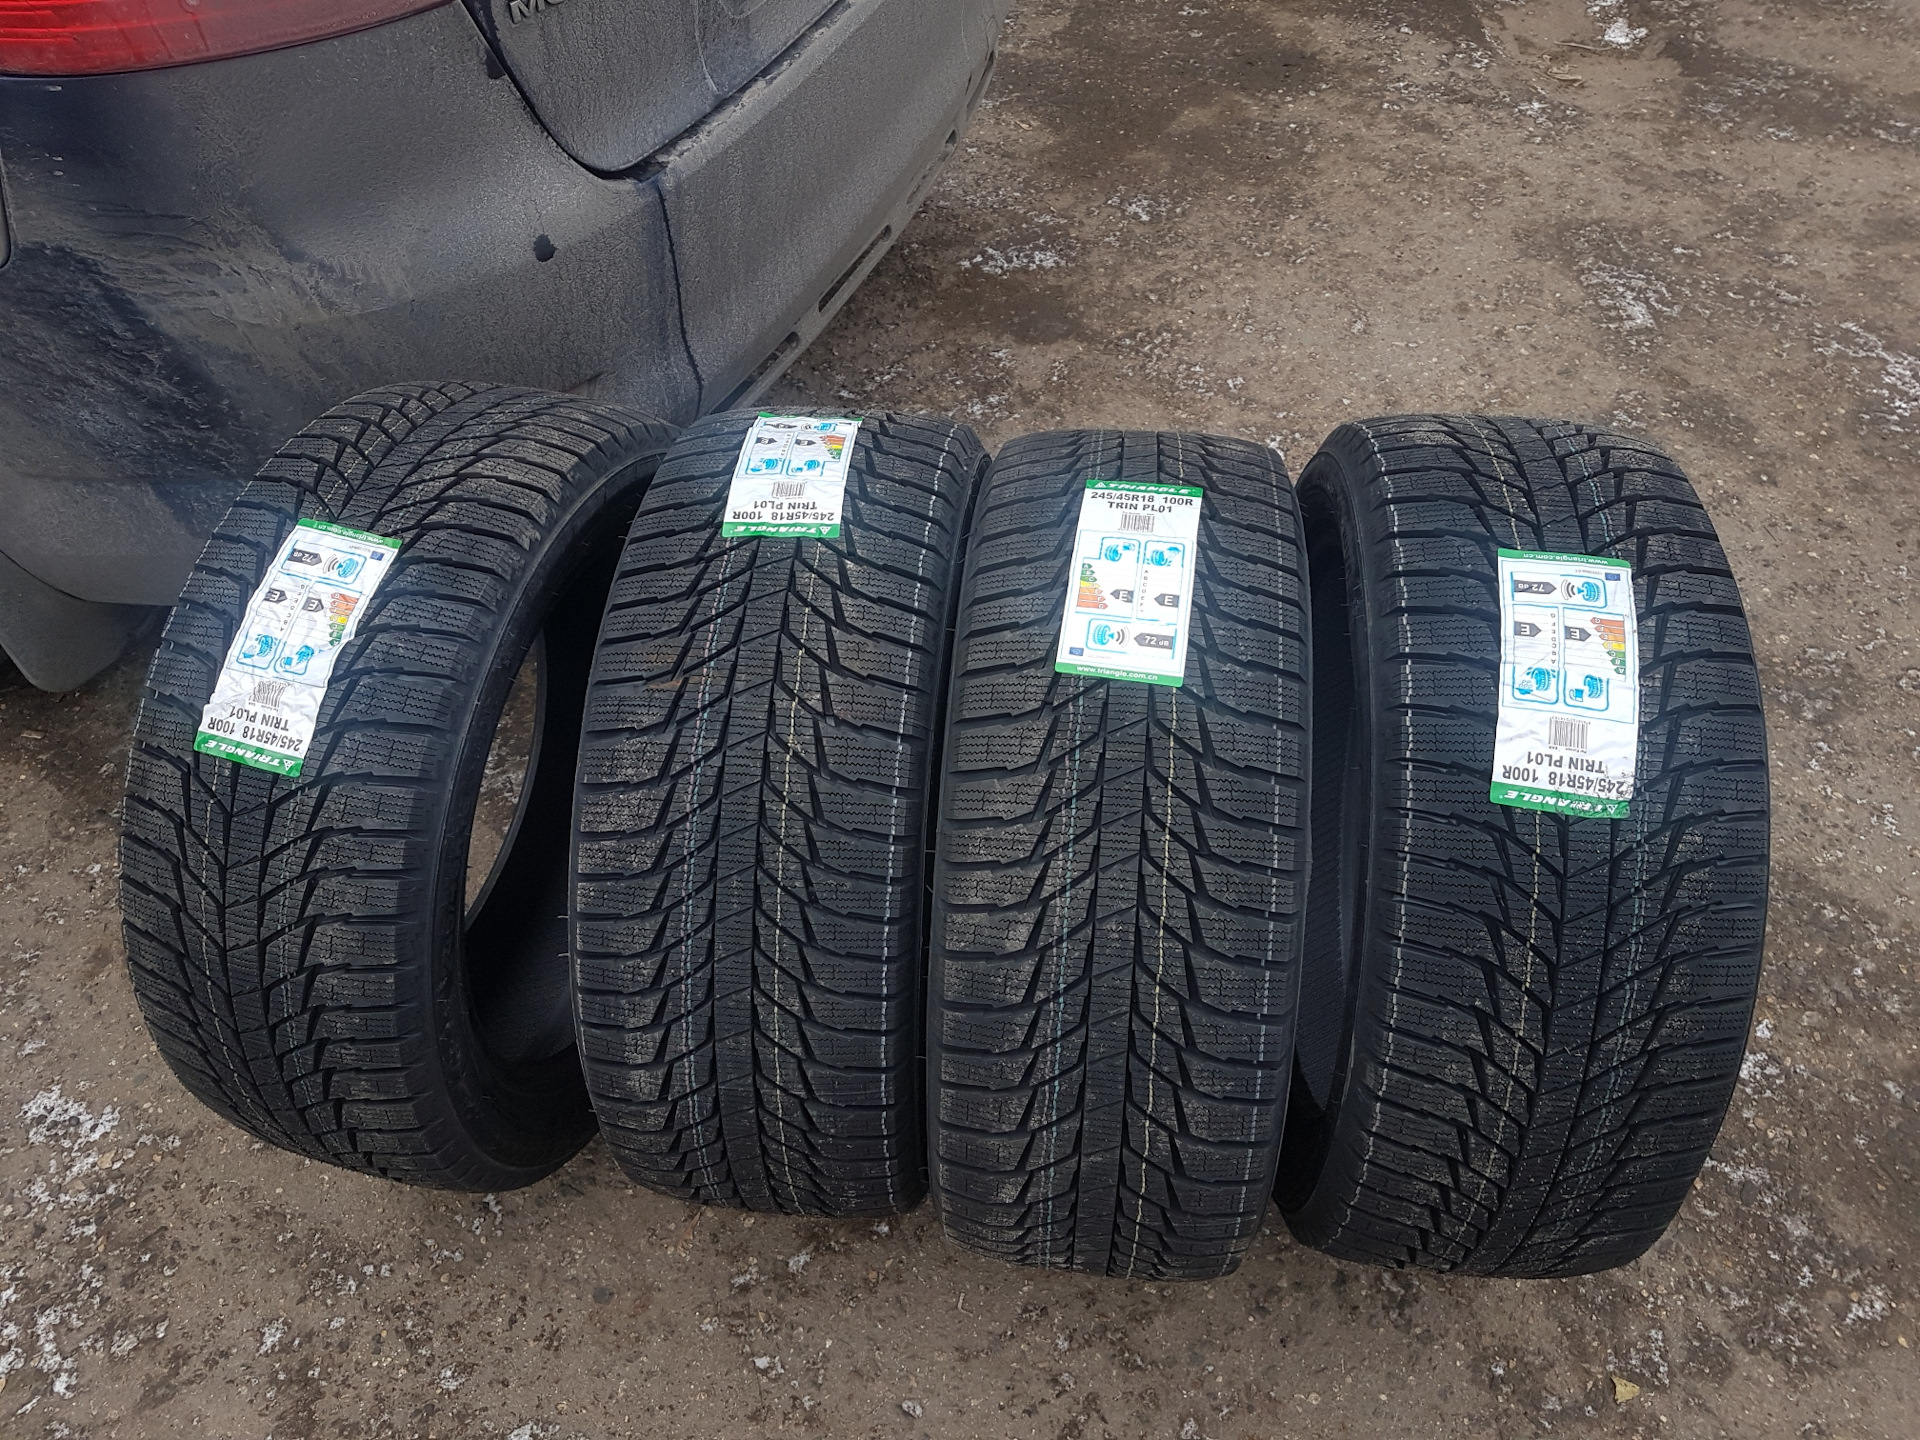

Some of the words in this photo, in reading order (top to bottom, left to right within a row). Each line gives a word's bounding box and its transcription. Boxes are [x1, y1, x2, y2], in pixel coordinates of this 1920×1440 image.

[1108, 483, 1191, 494] TRIANGLE
[1091, 491, 1154, 503] 245/45R18
[1162, 496, 1193, 506] 100R
[753, 500, 783, 509] PL01
[787, 502, 817, 510] TRIN
[1107, 501, 1138, 510] TRIN
[1142, 504, 1172, 513] PL01
[732, 511, 763, 520] 100R
[771, 511, 834, 521] 245/45R18
[734, 526, 817, 534] TRIANGLE
[303, 553, 313, 562] 72
[1523, 553, 1608, 565] www.triangle.com.cn
[269, 590, 280, 601] E
[1119, 591, 1128, 601] E
[1164, 596, 1173, 605] E
[308, 599, 319, 610] E
[1520, 624, 1530, 635] E
[1570, 628, 1580, 639] E
[1145, 636, 1157, 645] 72
[1076, 665, 1158, 680] www.triangle.com.cn
[208, 717, 236, 734] 100R
[261, 713, 289, 731] TRIN
[242, 726, 303, 751] 245/45R18
[204, 740, 281, 766] TRIANGLE
[1526, 752, 1563, 768] PL01
[1568, 757, 1604, 774] TRIN
[1502, 765, 1538, 782] 100R
[1548, 771, 1625, 795] 245/45R18
[1504, 790, 1603, 812] TRIANGLE
